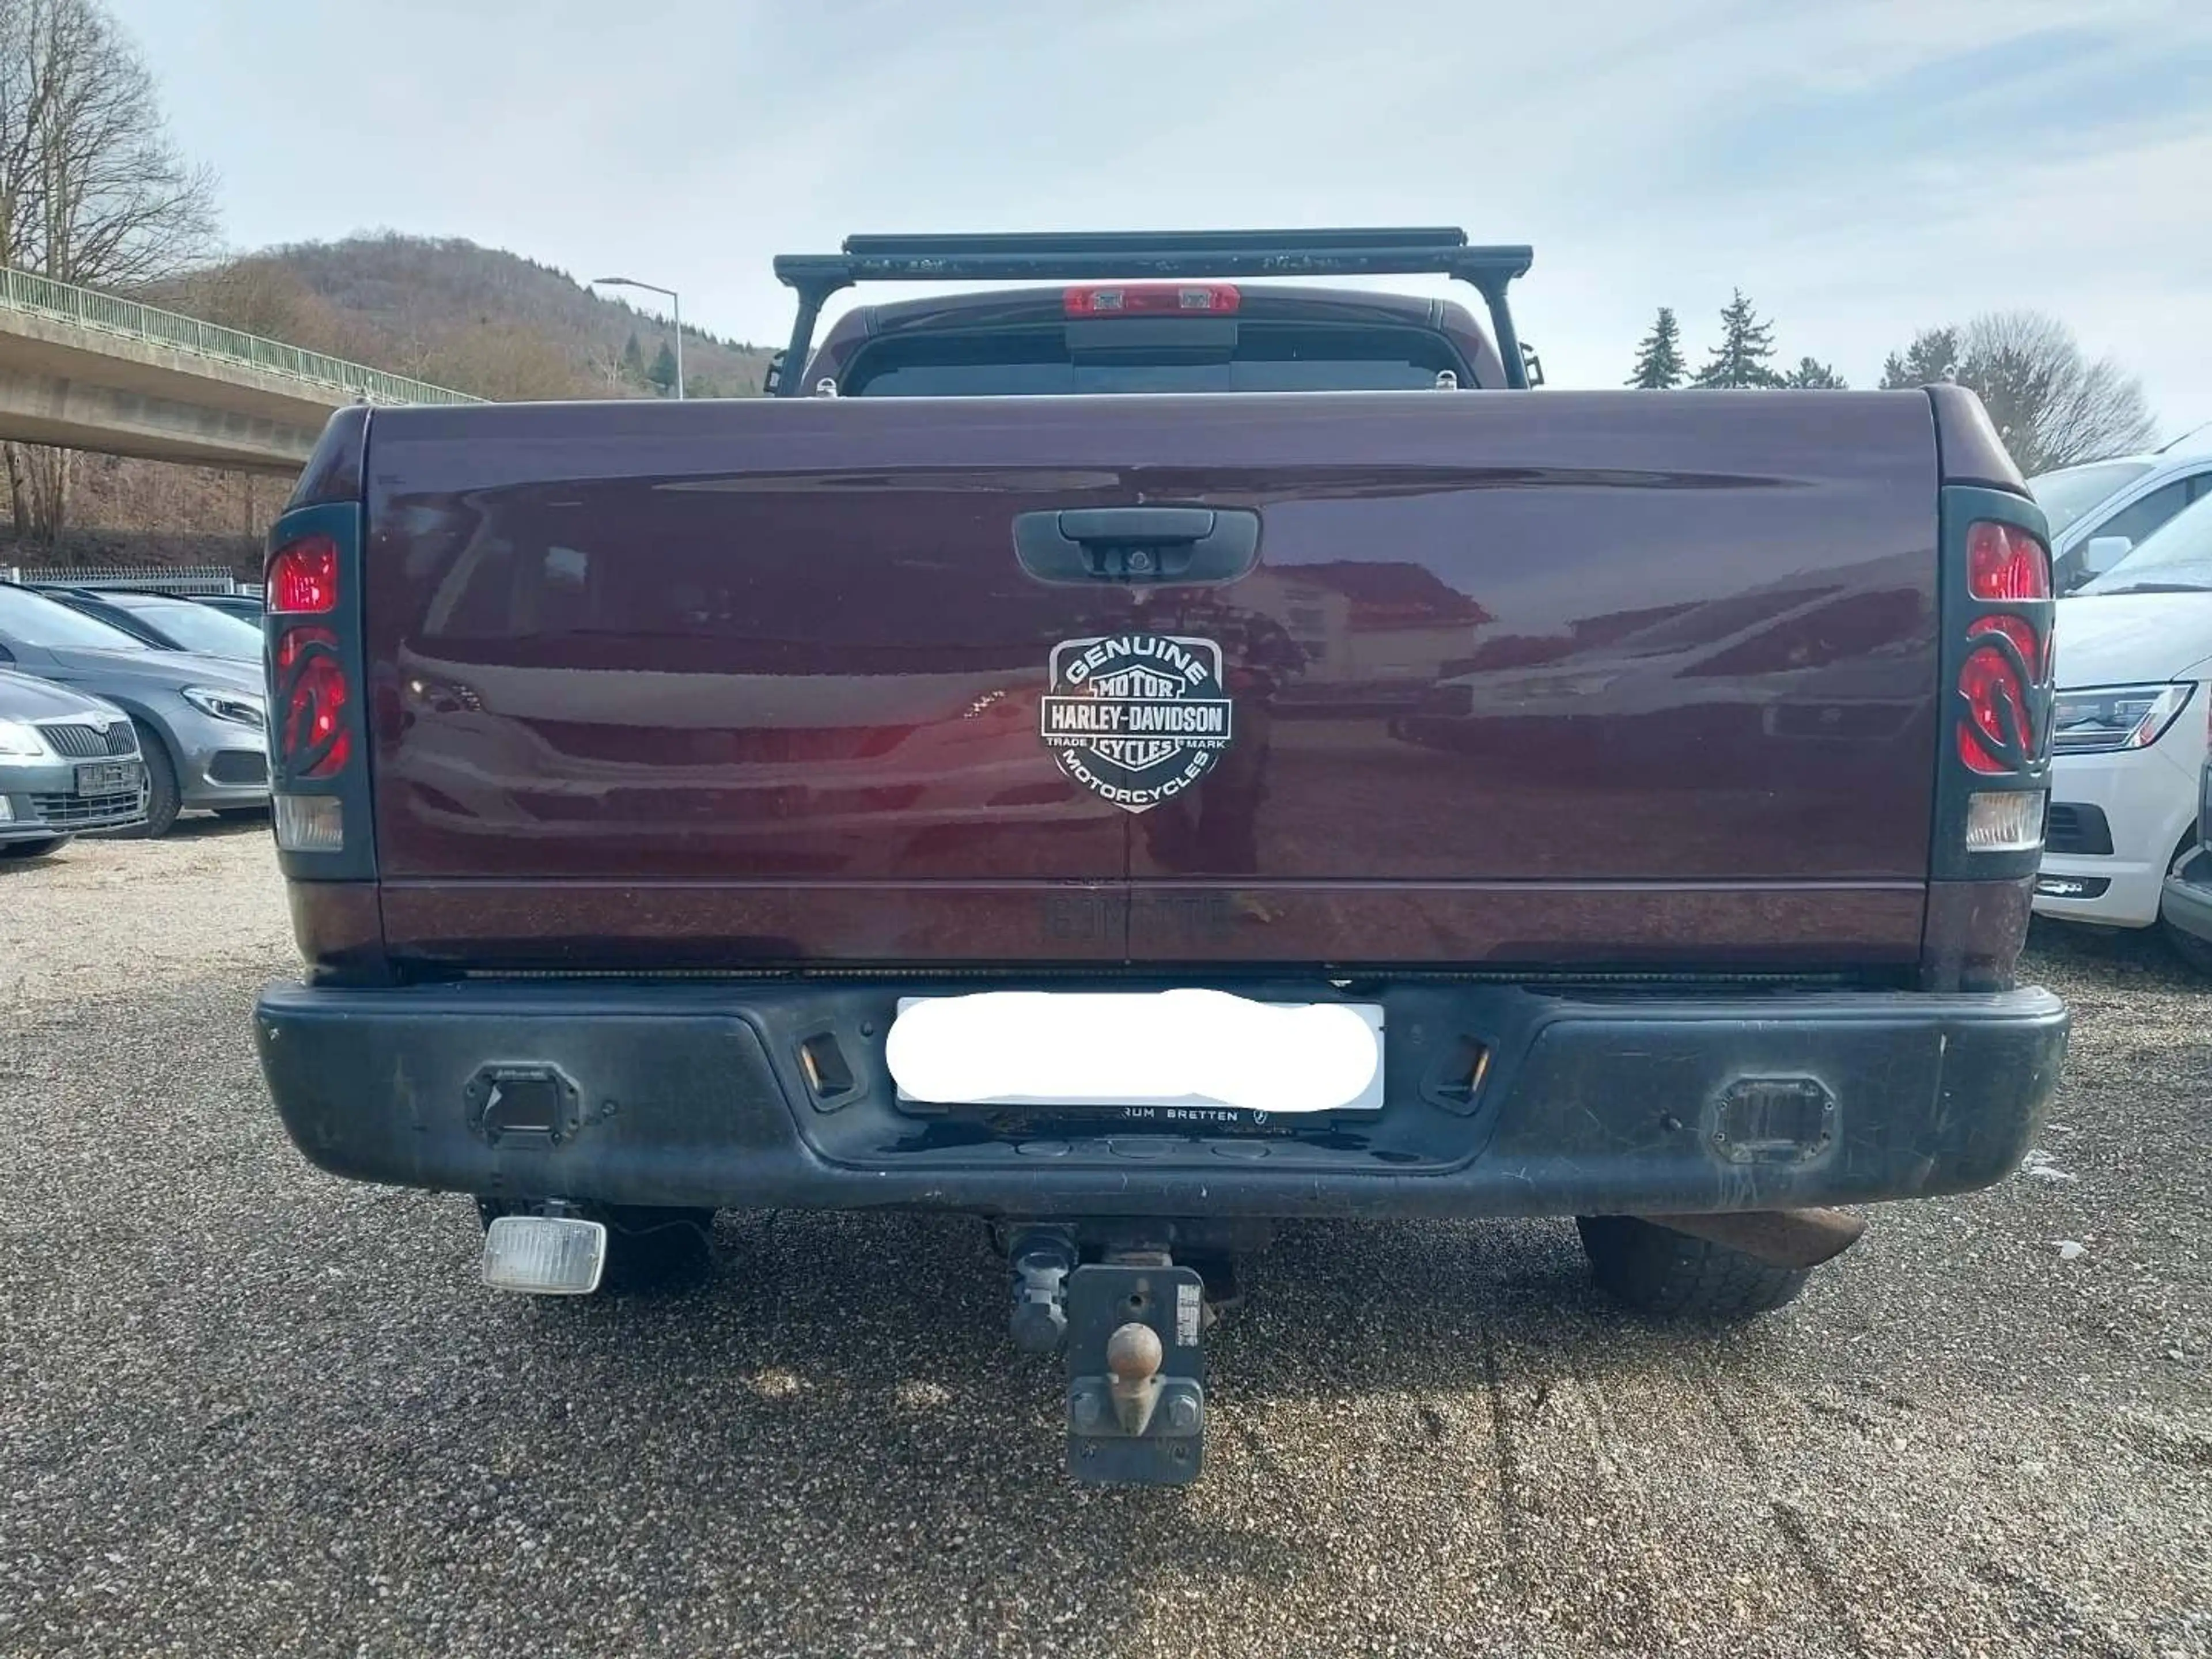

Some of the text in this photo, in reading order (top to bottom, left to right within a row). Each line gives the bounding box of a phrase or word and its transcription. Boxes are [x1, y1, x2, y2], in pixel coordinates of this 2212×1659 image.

[1066, 637, 1207, 685] GENUINE
[1100, 670, 1173, 696] MOTOR
[1052, 705, 1222, 732] HARLEY-DAVIDSON
[1047, 737, 1225, 748] TRADE MARK
[1100, 740, 1171, 766] CYCLES
[1063, 749, 1209, 803] MOTORCYCLES
[1167, 1109, 1237, 1121] BRETTEN
